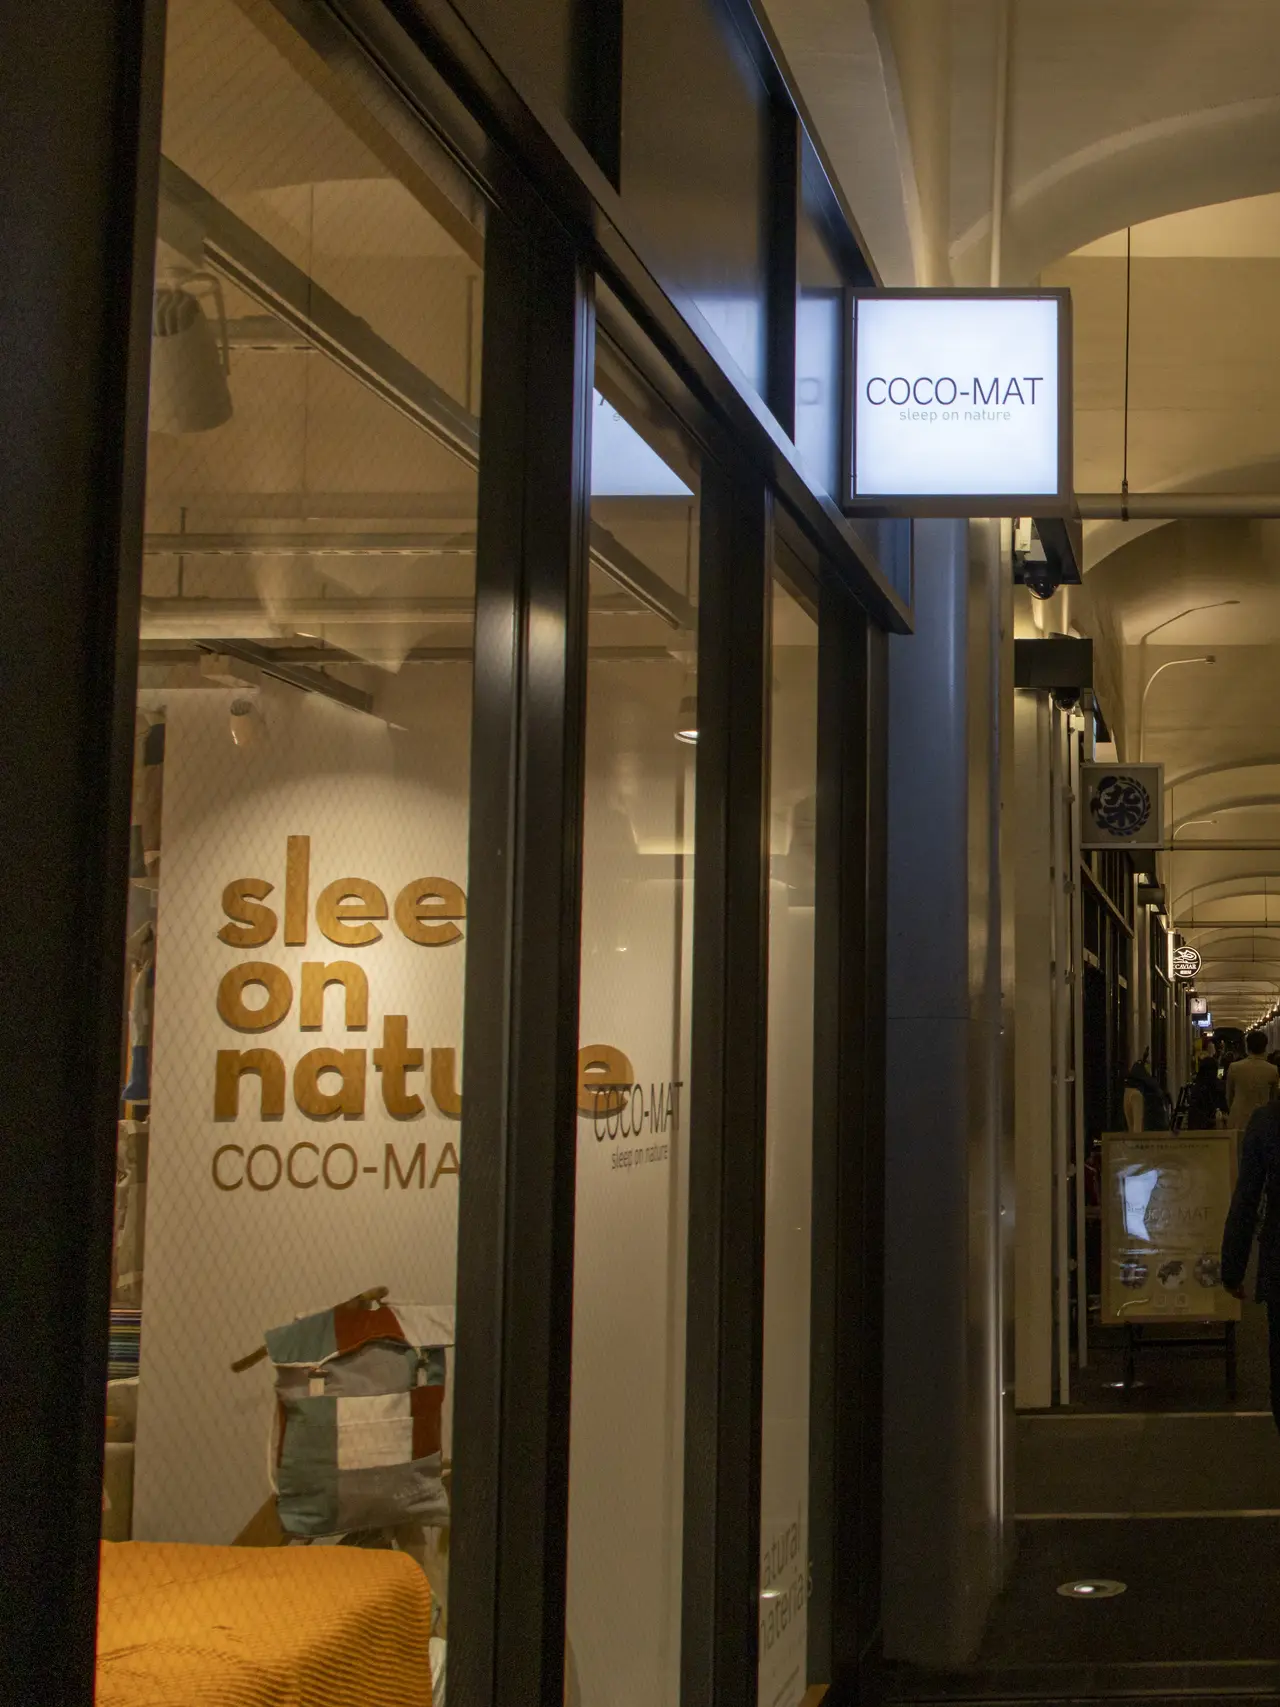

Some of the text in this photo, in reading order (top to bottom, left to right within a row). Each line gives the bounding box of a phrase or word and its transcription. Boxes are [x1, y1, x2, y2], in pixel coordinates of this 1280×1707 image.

[866, 376, 1044, 406] COCO-MAT
[899, 408, 1011, 424] sleep on nature
[217, 835, 468, 948] slee
[216, 960, 370, 1034] on
[594, 1082, 683, 1142] COCO-MAT
[212, 1141, 462, 1192] COCO-MA
[612, 1144, 668, 1173] sleep on nature
[763, 1500, 802, 1589] atural
